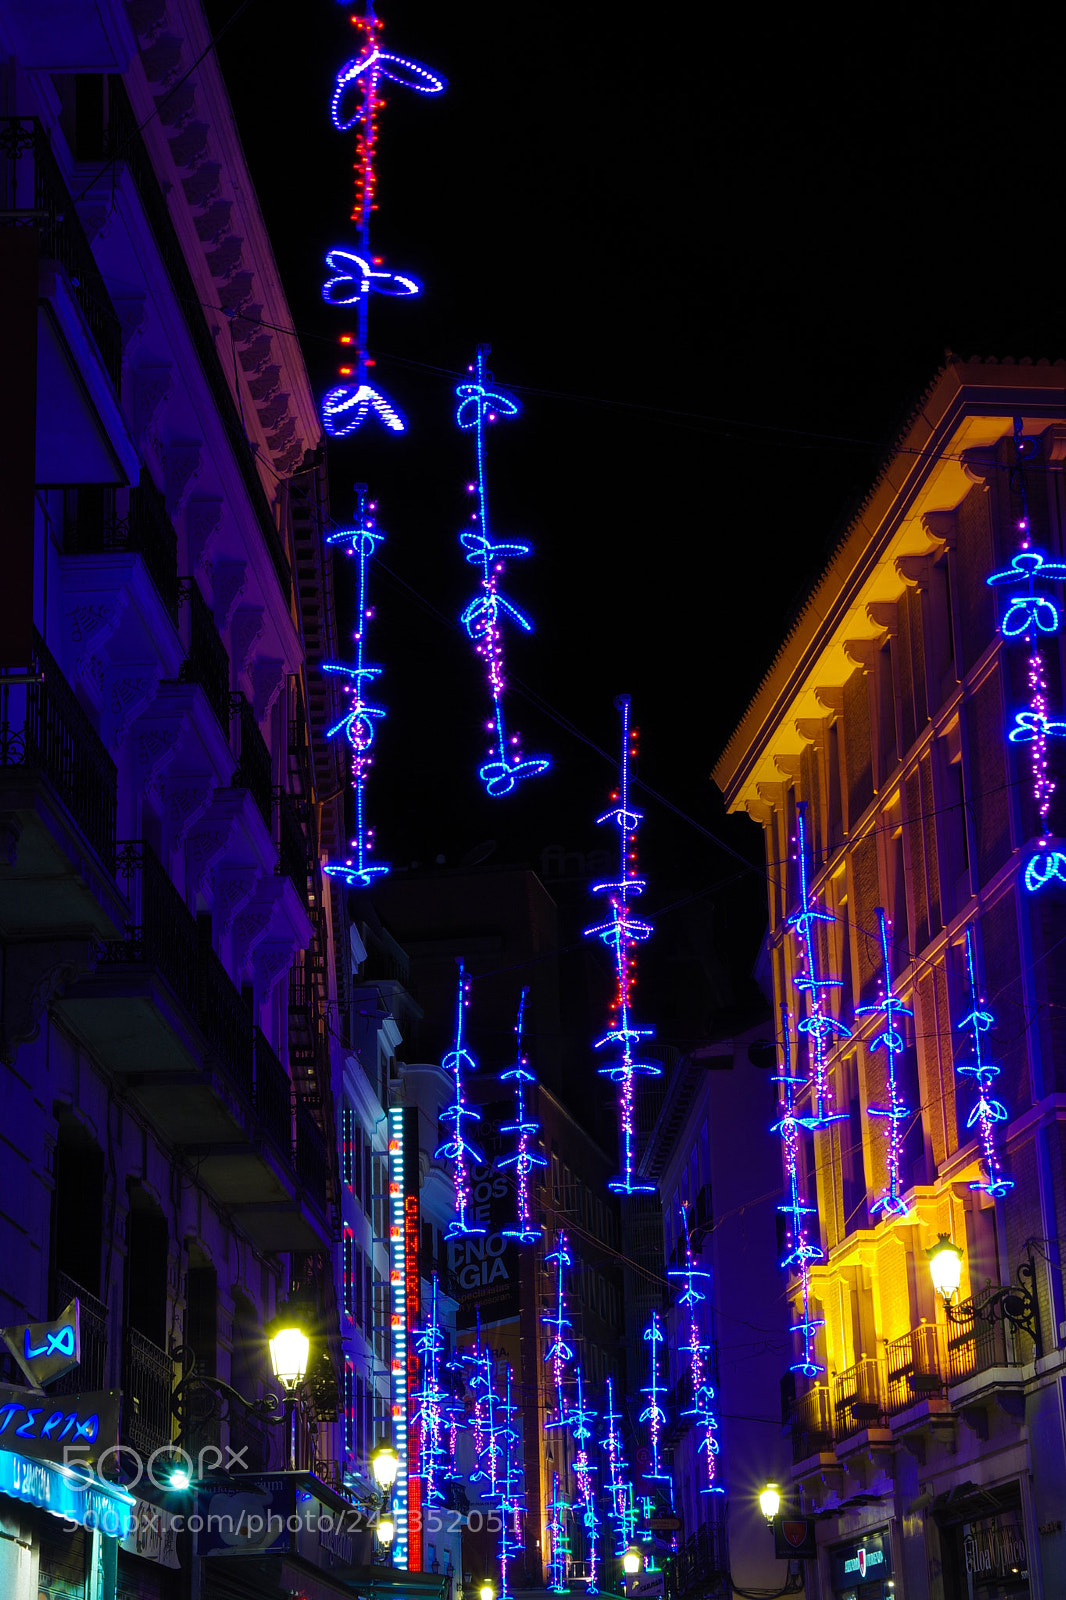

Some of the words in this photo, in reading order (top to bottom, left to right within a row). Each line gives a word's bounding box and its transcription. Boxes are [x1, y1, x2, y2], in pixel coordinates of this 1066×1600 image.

[540, 844, 616, 878] fna
[389, 1140, 399, 1150] 40
[390, 1183, 399, 1193] 35
[390, 1226, 400, 1237] 30
[391, 1271, 400, 1281] 25
[391, 1315, 401, 1325] 20
[24, 1325, 75, 1359] LA
[392, 1405, 401, 1416] 10
